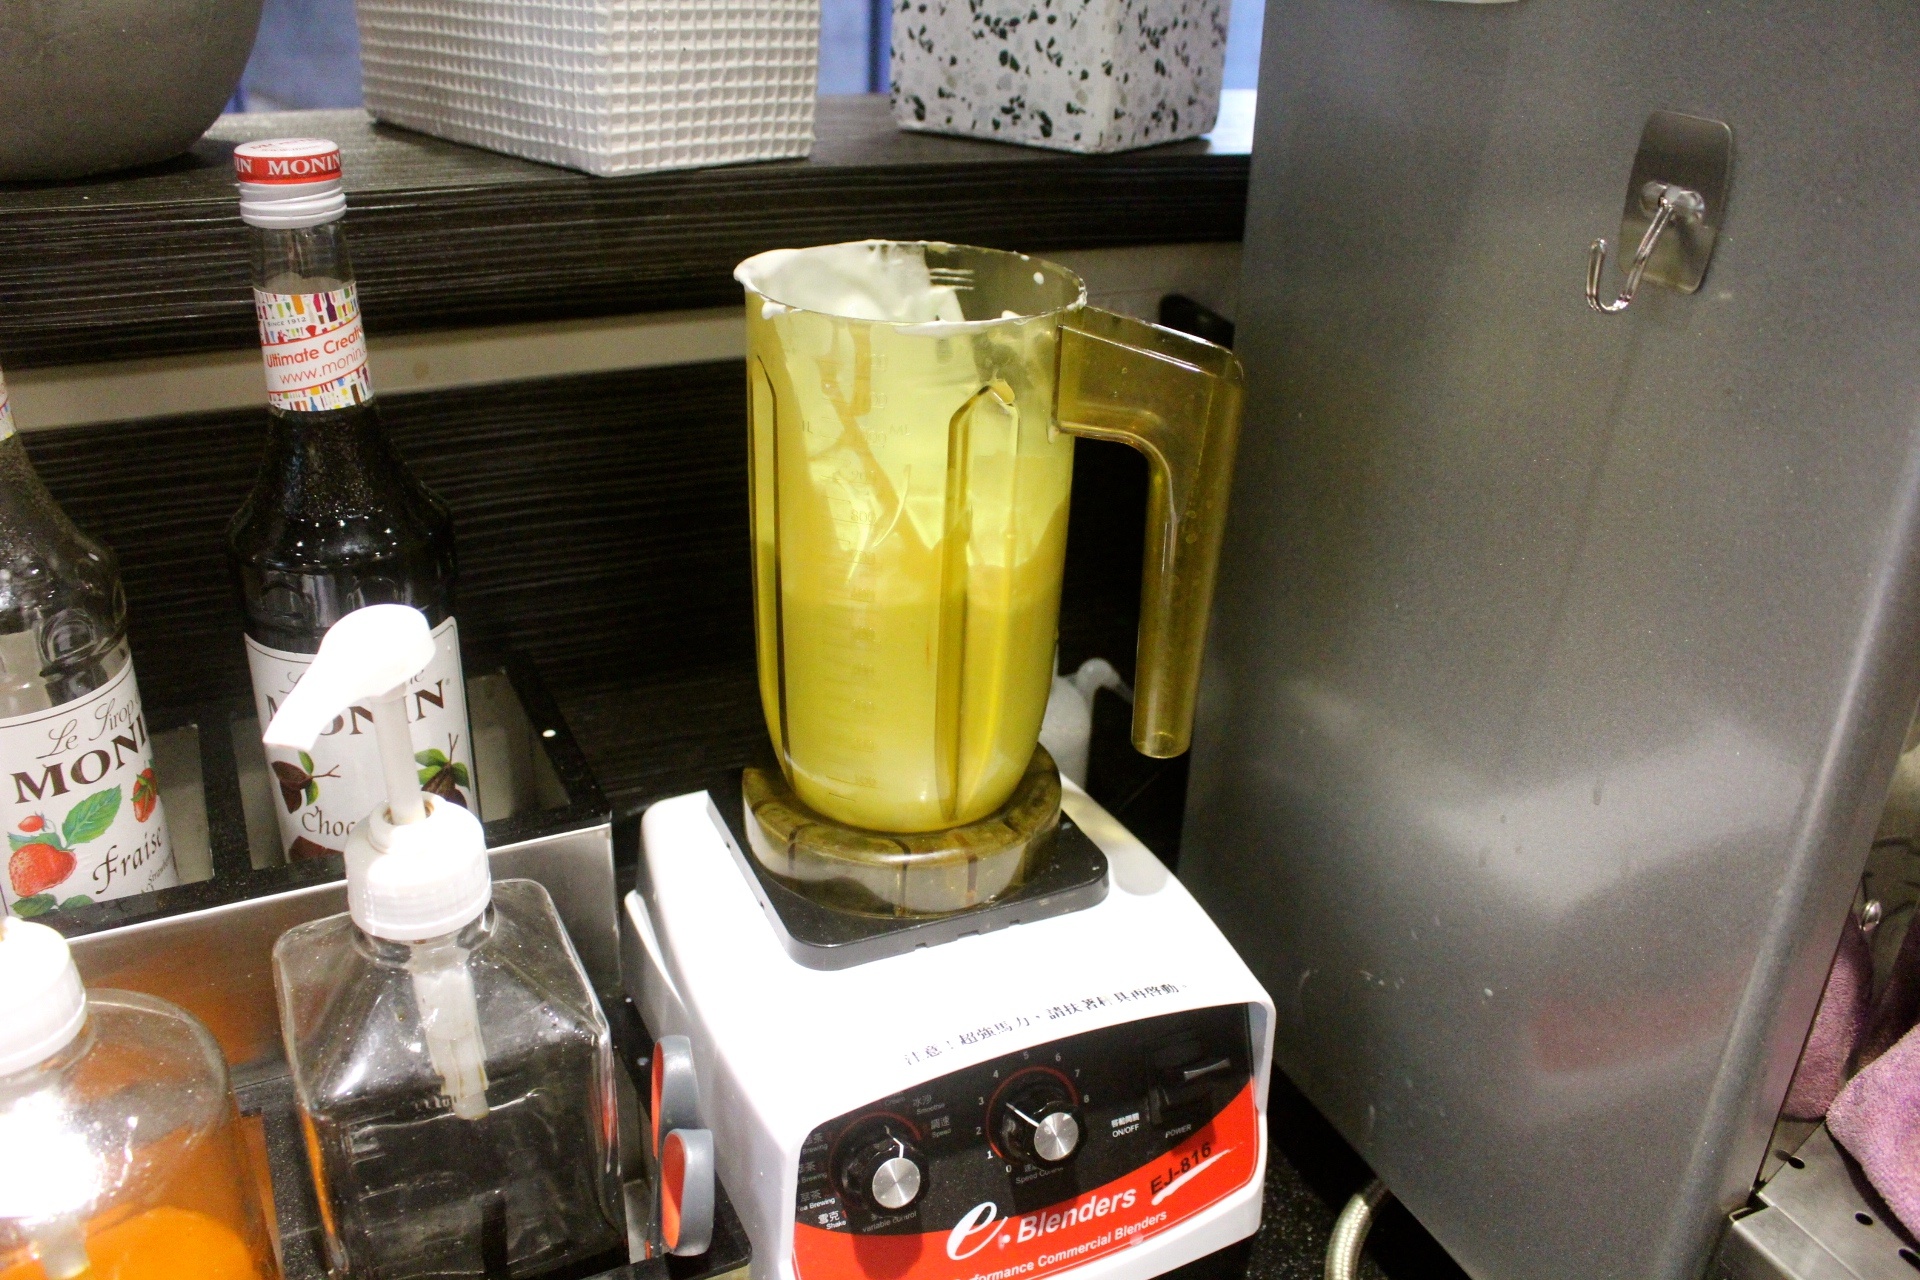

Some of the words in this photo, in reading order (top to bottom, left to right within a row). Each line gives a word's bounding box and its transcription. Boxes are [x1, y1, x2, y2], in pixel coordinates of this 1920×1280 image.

[267, 153, 341, 175] MONIN
[287, 316, 306, 325] 1912
[266, 348, 320, 368] Ultimate
[36, 719, 78, 760] Le
[88, 697, 135, 742] Sirop
[93, 825, 164, 895] Fraise
[1023, 1052, 1030, 1060] 5
[1055, 1053, 1062, 1062] 6
[992, 1069, 999, 1079] 4
[1074, 1068, 1081, 1078] 7
[978, 1096, 985, 1105] 3
[1083, 1094, 1090, 1103] 8
[976, 1126, 982, 1135] 2
[1112, 1123, 1140, 1138] ON/OFF
[1165, 1123, 1192, 1138] POWER
[986, 1150, 993, 1159] 1
[1005, 1165, 1012, 1173] 0
[1150, 1141, 1212, 1196] EJ-816
[809, 1198, 836, 1210] Brewing
[1016, 1187, 1137, 1244] Blenders
[826, 1220, 847, 1231] Shake
[862, 1218, 891, 1233] variable
[1037, 1231, 1112, 1268] Commercial
[1114, 1210, 1168, 1241] Blenders
